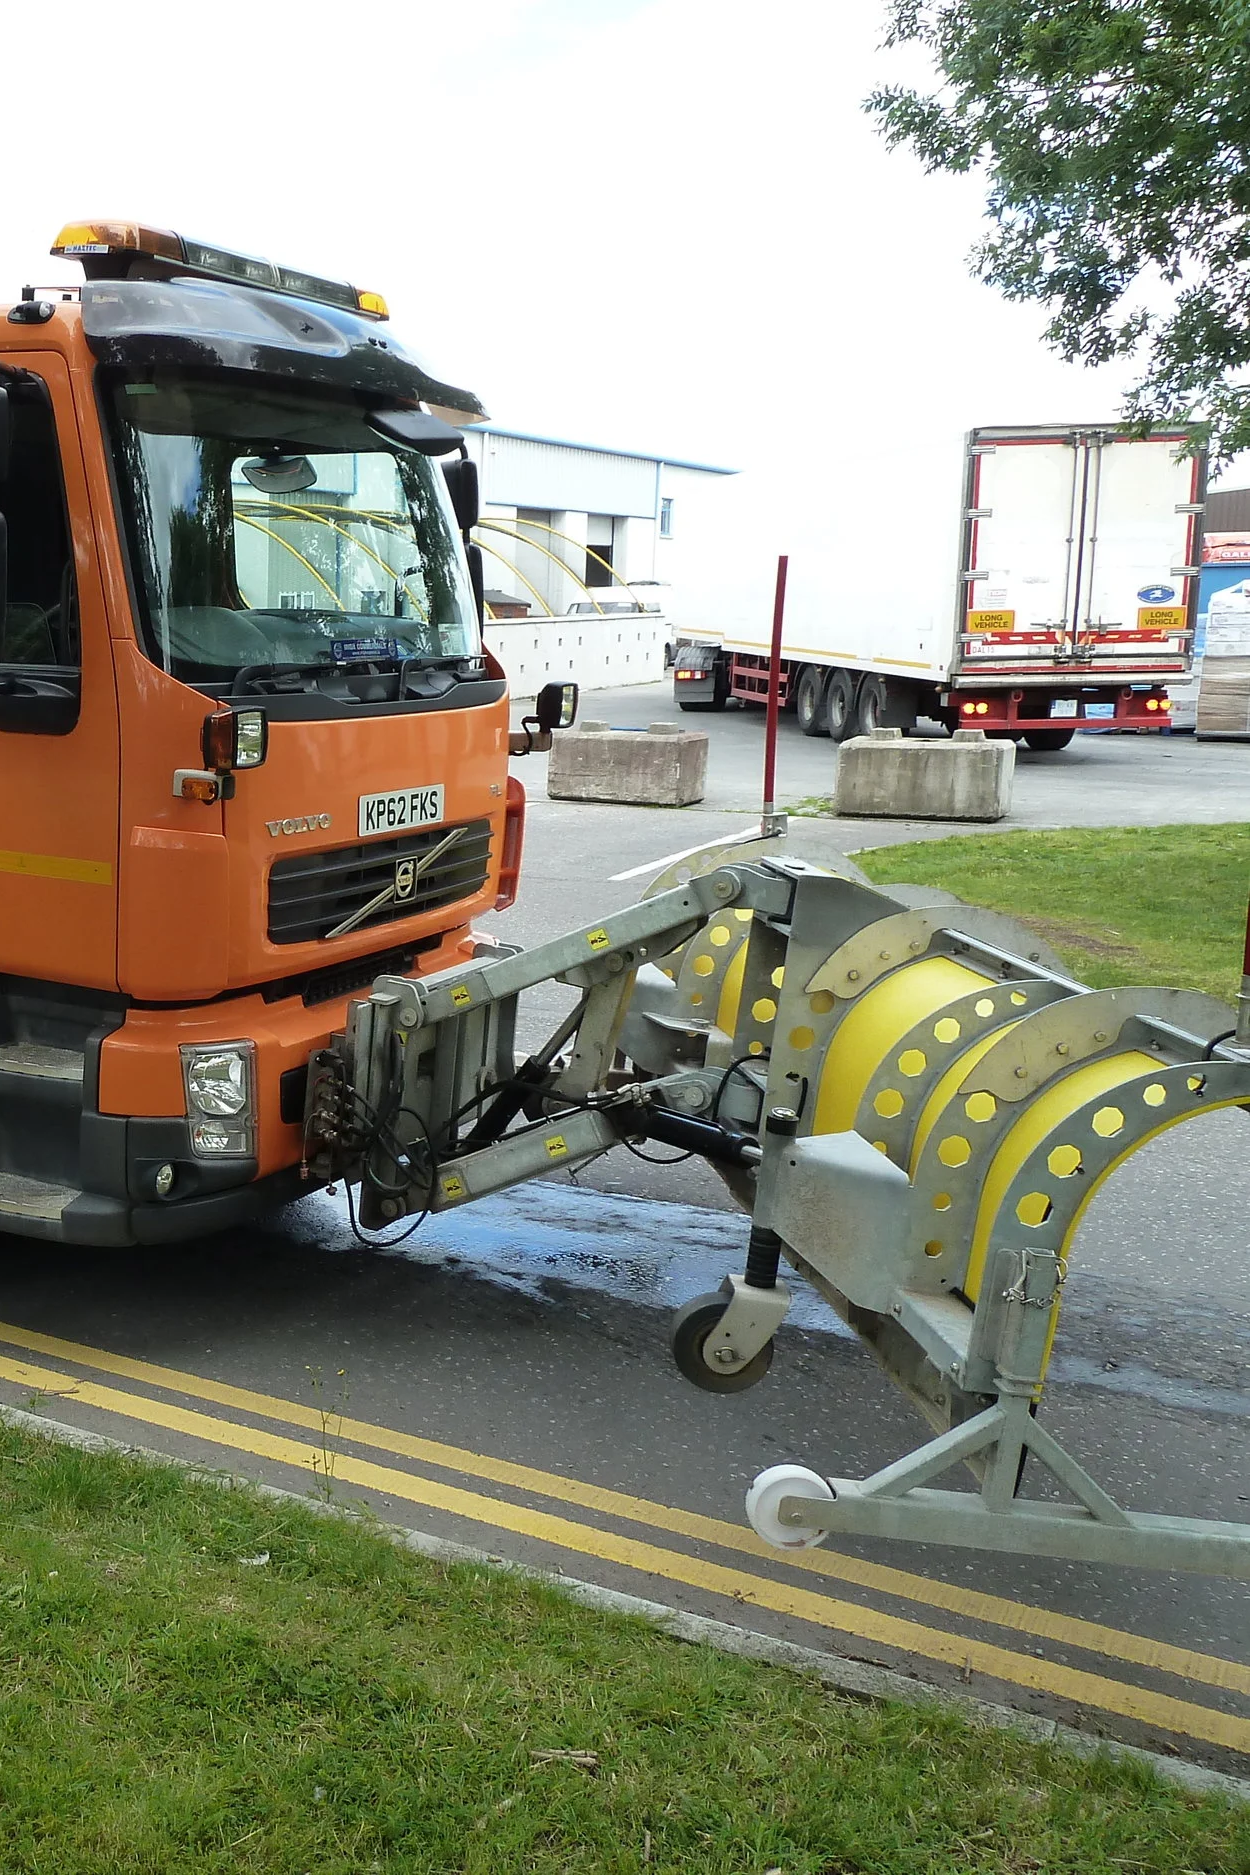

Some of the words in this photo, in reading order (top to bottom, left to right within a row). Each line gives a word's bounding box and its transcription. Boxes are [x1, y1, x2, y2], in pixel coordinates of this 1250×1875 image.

[979, 614, 1003, 622] LONG
[1150, 611, 1173, 619] LONG
[974, 621, 1009, 629] VEHICLE
[1144, 617, 1180, 625] VEHICLE
[366, 797, 407, 831] KP62
[410, 790, 438, 823] FKS
[265, 813, 333, 838] VOLVO
